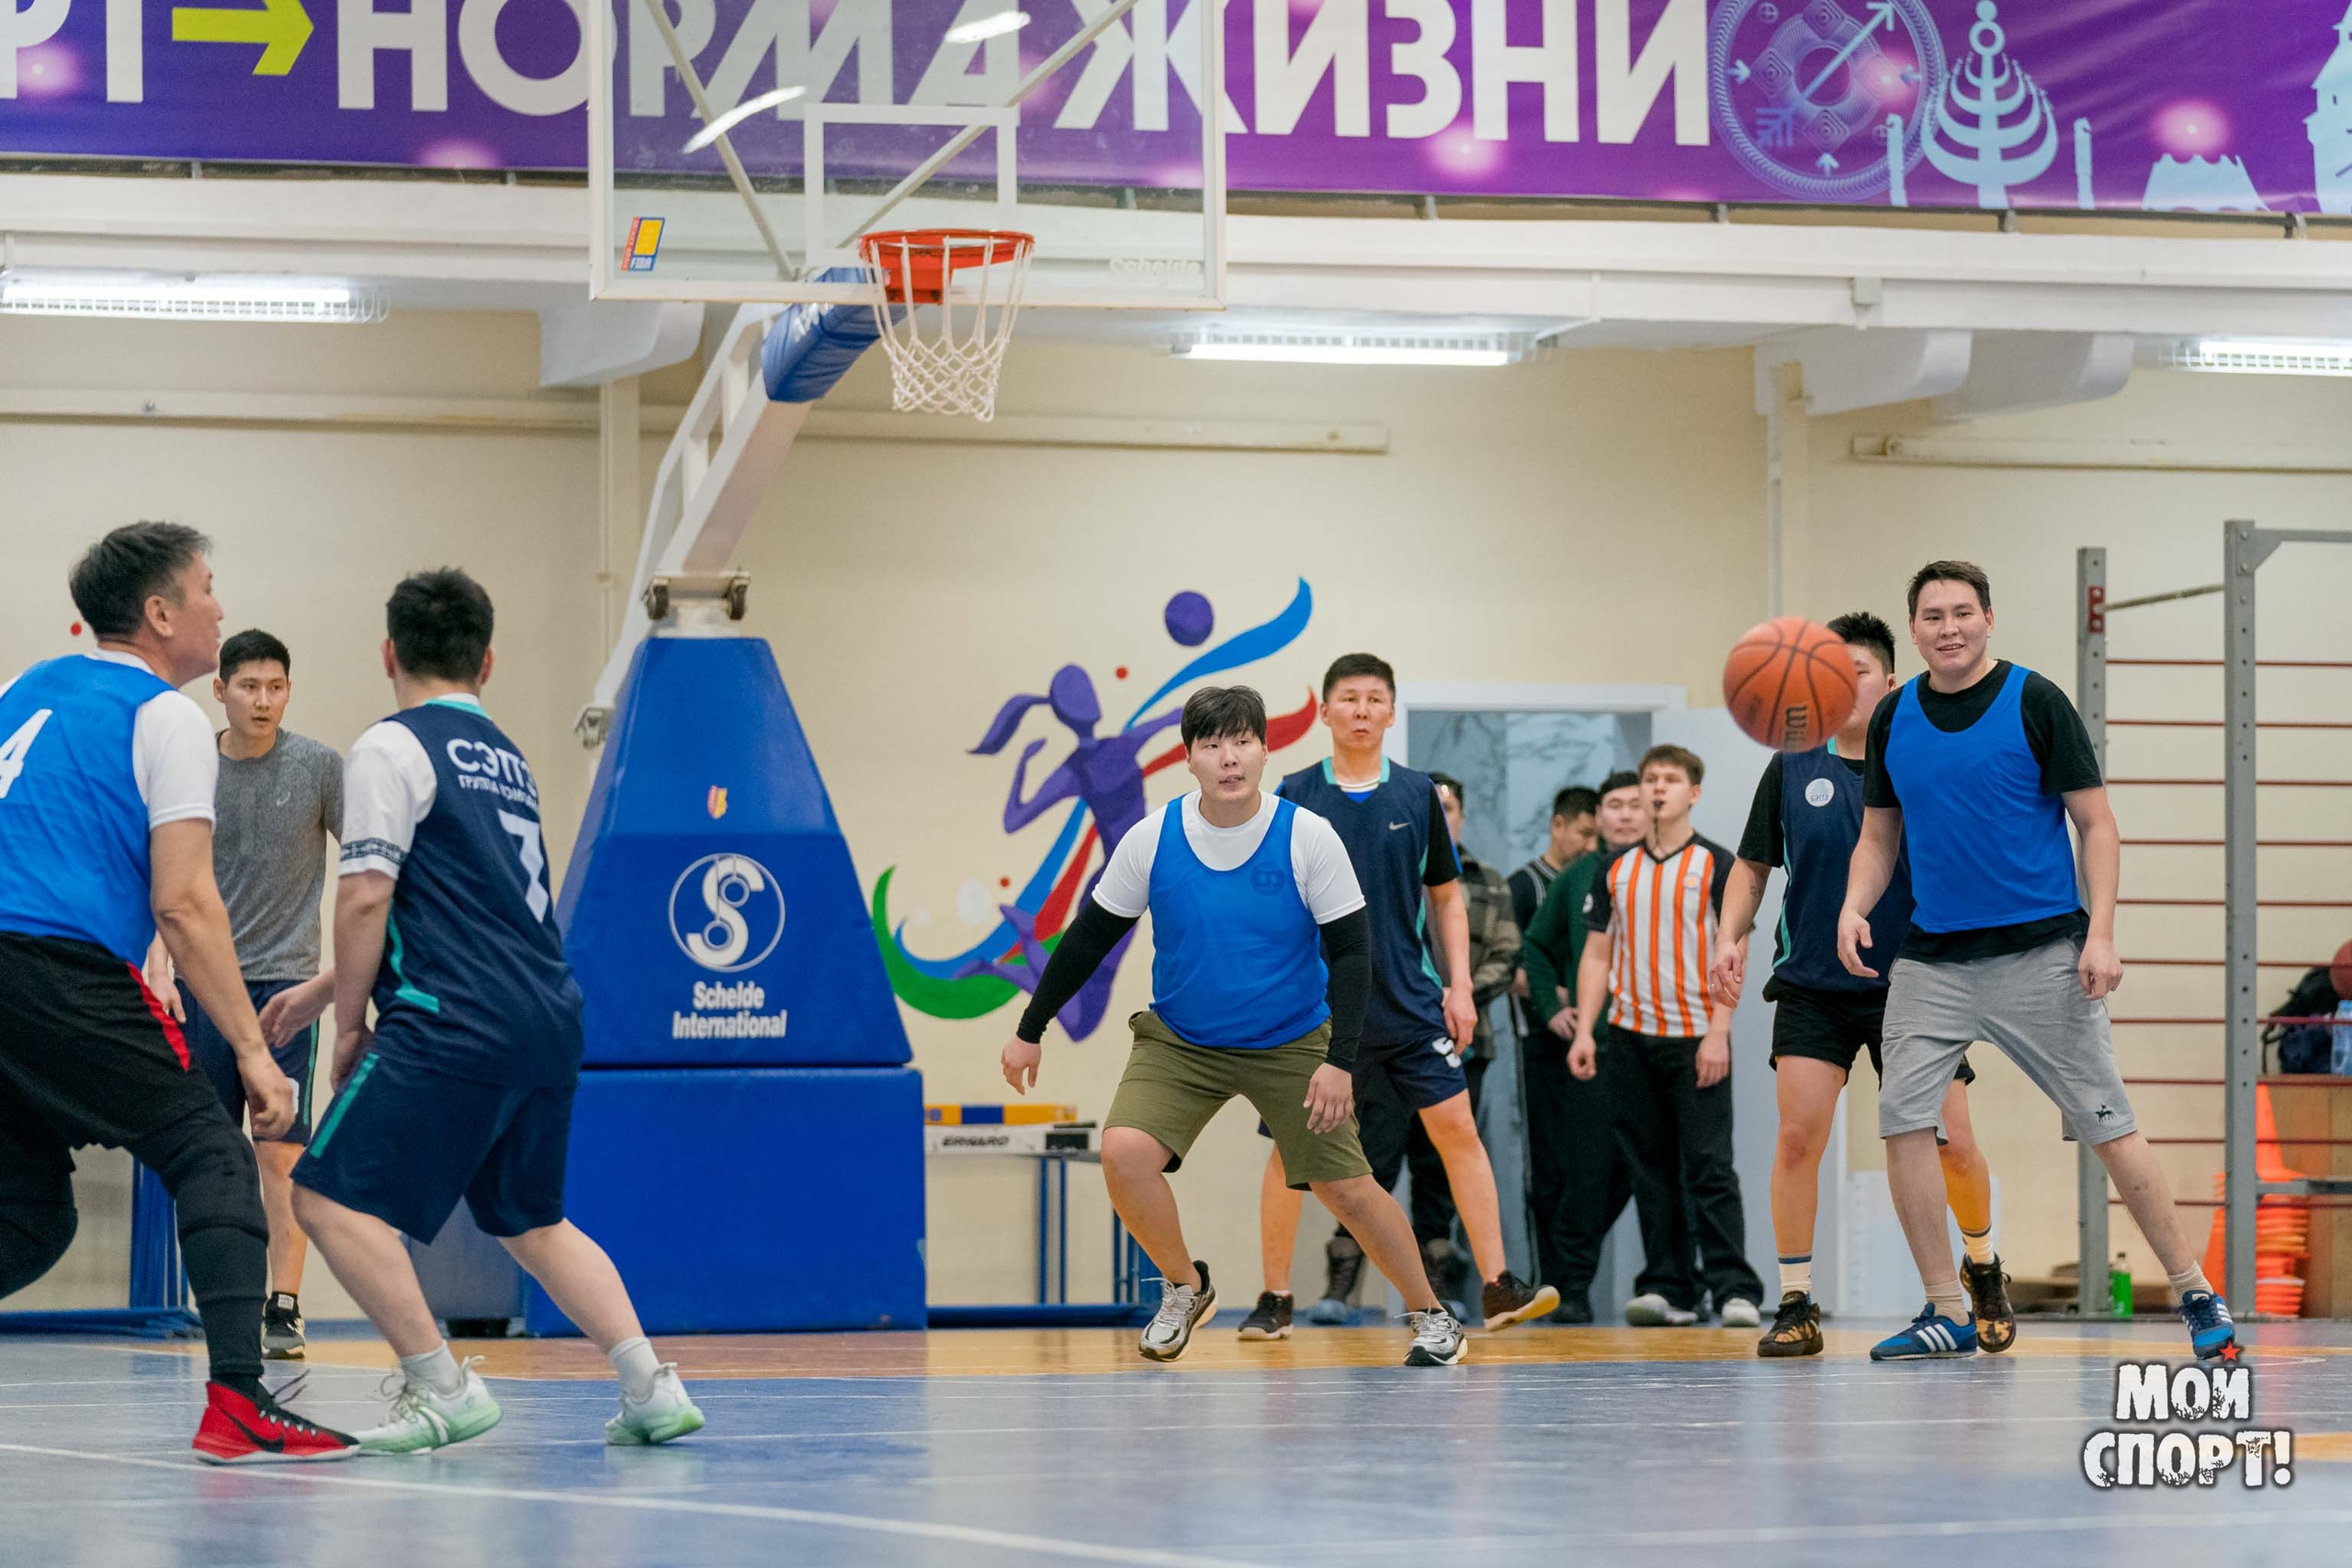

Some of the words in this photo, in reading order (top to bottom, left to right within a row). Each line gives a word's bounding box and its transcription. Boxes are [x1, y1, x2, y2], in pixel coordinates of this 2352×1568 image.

[497, 807, 549, 923] 7
[693, 980, 765, 1010] Schelde
[672, 1009, 787, 1039] International
